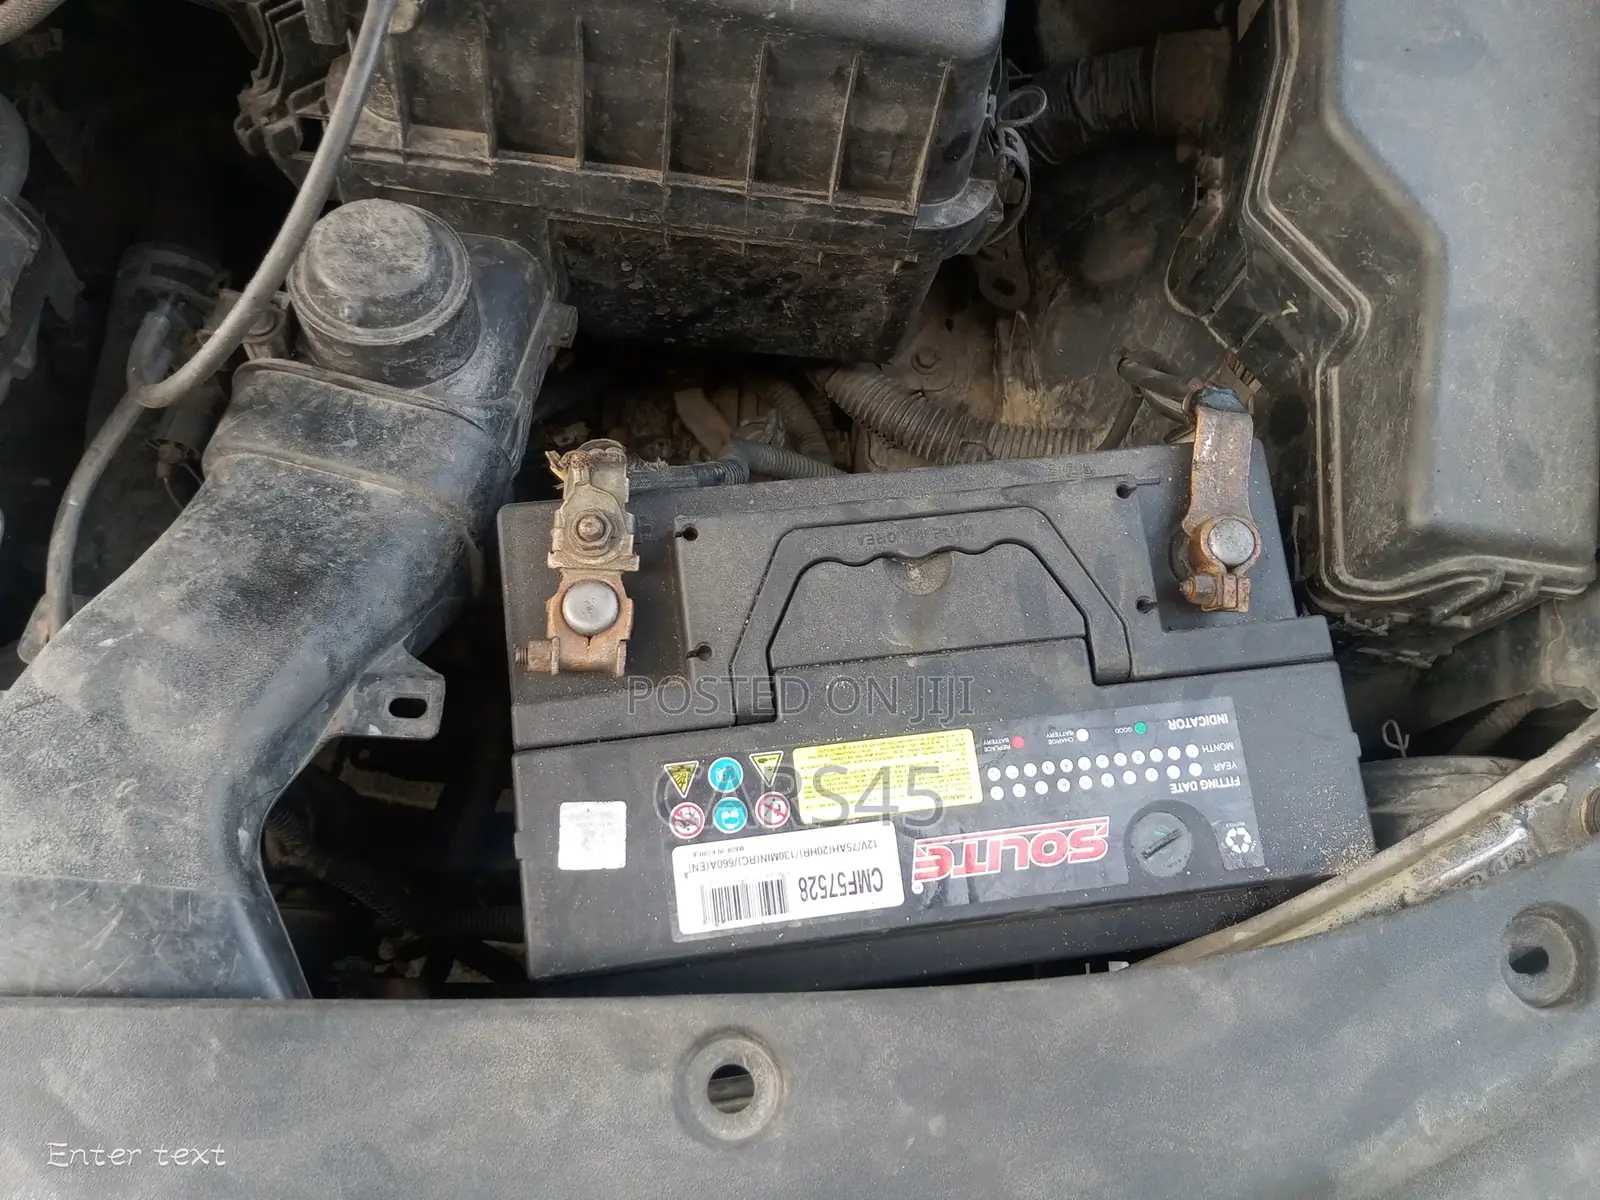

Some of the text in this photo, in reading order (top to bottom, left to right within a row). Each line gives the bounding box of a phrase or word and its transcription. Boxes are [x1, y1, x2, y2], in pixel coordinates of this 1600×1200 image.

[1167, 713, 1229, 731] INDICATOR
[1045, 730, 1074, 740] BATTERY
[1114, 725, 1133, 735] GOOD
[982, 737, 1010, 747] BATTERY
[1047, 736, 1075, 746] CHARGE
[1201, 741, 1234, 754] MONTH
[983, 744, 1011, 753] REPLACE
[1212, 760, 1238, 773] YEAR
[1169, 775, 1241, 794] FITTING DATE
[912, 819, 1109, 882] SOLITE
[797, 867, 884, 902] CMF57528
